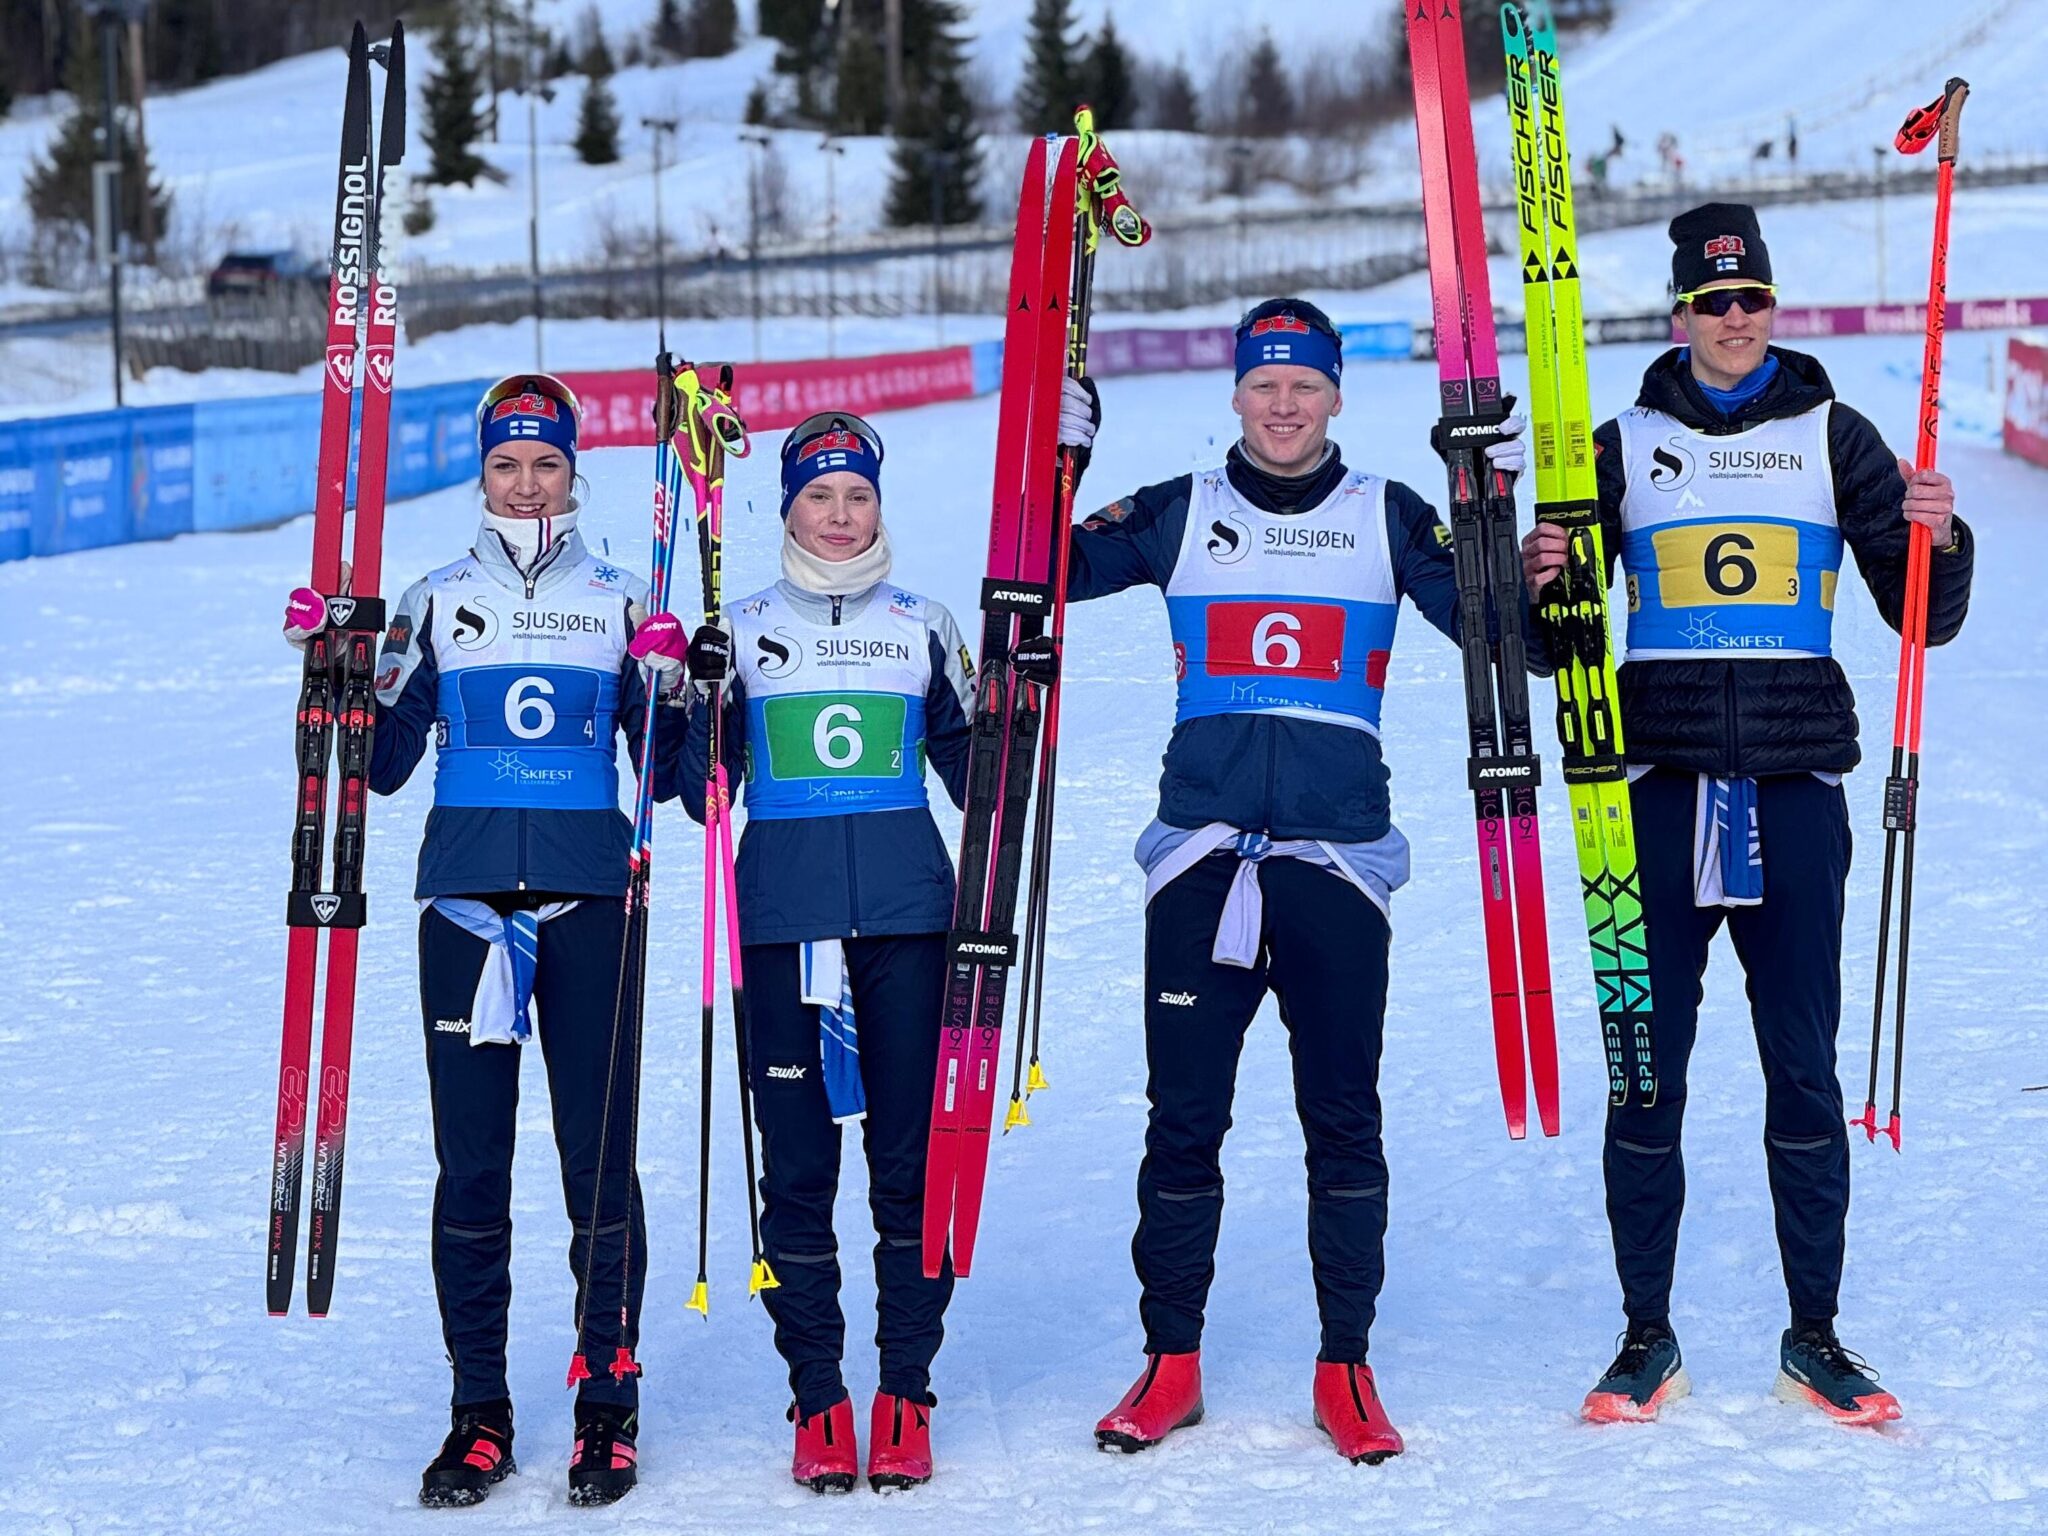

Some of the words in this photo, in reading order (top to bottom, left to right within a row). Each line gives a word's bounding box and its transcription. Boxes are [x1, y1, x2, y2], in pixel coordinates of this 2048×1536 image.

[1510, 53, 1538, 235] FISCHER
[1539, 49, 1568, 232] FISCHER
[335, 156, 368, 327] ROSSIGNOL
[1450, 424, 1501, 438] ATOMIC
[1709, 451, 1803, 471] SJUSJØEN
[1264, 527, 1355, 549] SJUSJØEN
[1703, 532, 1758, 597] 6
[992, 590, 1043, 603] ATOMIC
[1787, 577, 1798, 597] 3
[512, 612, 607, 634] SJUSJØEN
[816, 639, 909, 661] SJUSJØEN
[1251, 611, 1302, 669] 6
[1717, 635, 1785, 648] SKIFEST
[1331, 659, 1340, 673] 1
[504, 676, 556, 739] 6
[583, 719, 593, 739] 4
[813, 703, 864, 769] 6
[891, 750, 901, 768] 2
[520, 769, 573, 780] SKIFEST
[1479, 766, 1531, 777] ATOMIC
[957, 942, 1008, 955] ATOMIC
[1158, 991, 1197, 1006] swix
[434, 1019, 472, 1033] swix
[1606, 1022, 1625, 1092] SPEED
[1635, 1022, 1654, 1092] SPEED
[766, 1065, 807, 1079] swix
